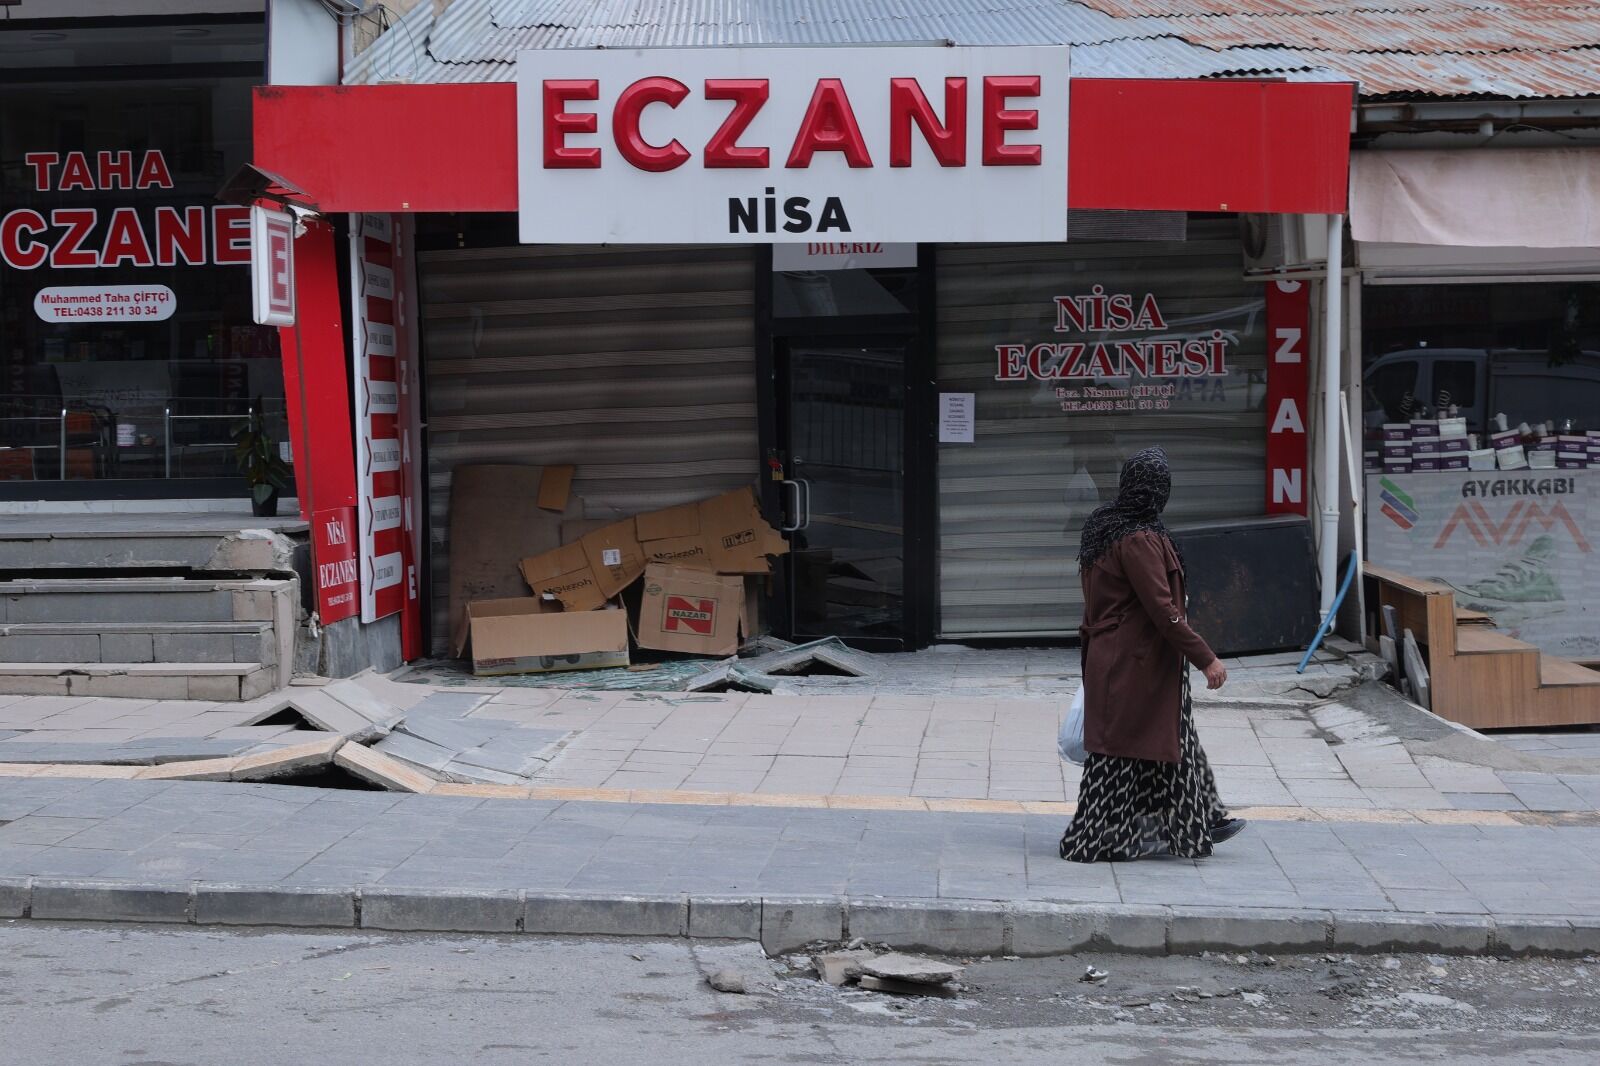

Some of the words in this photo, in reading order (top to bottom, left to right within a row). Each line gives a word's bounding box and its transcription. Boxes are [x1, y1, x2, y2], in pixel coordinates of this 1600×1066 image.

[543, 75, 1042, 172] ECZANE
[25, 150, 173, 191] TAHA
[728, 187, 852, 233] NİSA
[41, 294, 102, 304] Muhammed
[105, 293, 130, 303] Taha
[134, 291, 169, 304] ÇİFTÇİ
[54, 307, 103, 317] TEL:0438
[106, 307, 124, 316] 211
[129, 306, 141, 315] 30
[145, 306, 158, 315] 34
[1053, 284, 1167, 332] NİSA
[995, 329, 1229, 381] ECZANESİ
[1462, 478, 1575, 498] AYAKKABI
[326, 516, 346, 546] NİSA
[1433, 498, 1594, 553] AVM
[320, 551, 358, 589] ECZANESİ
[672, 610, 707, 619] NAZAR
